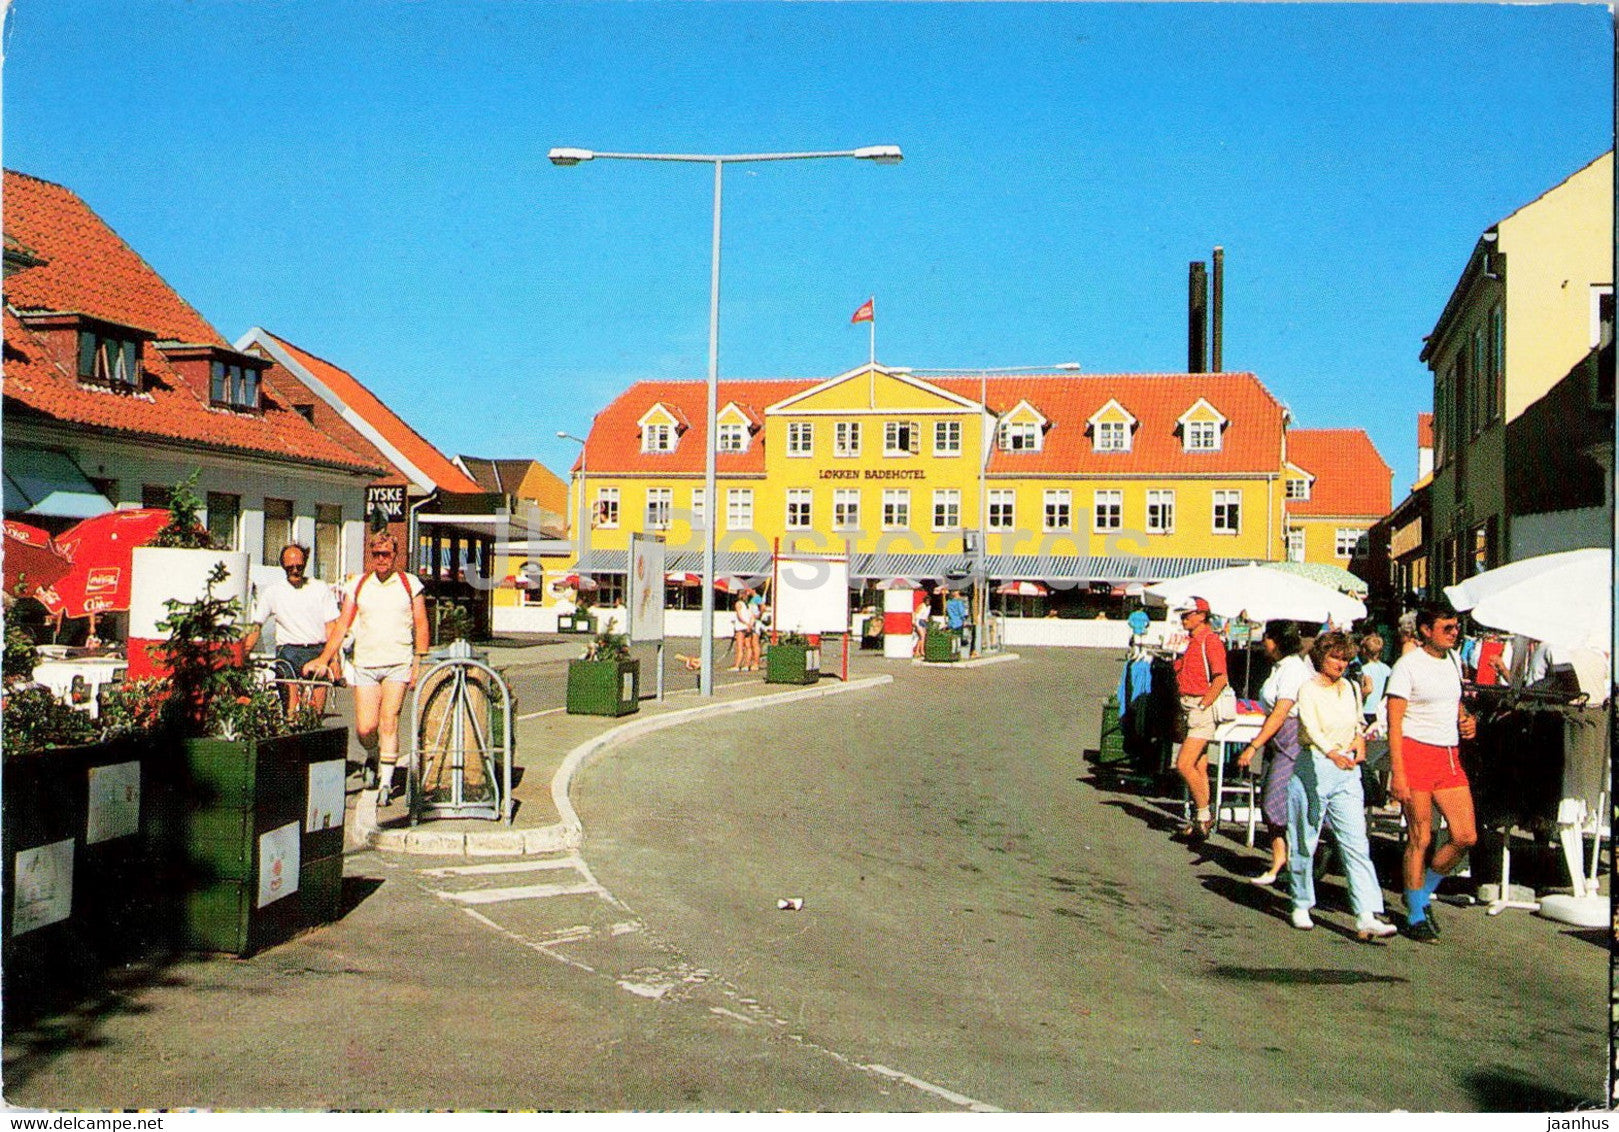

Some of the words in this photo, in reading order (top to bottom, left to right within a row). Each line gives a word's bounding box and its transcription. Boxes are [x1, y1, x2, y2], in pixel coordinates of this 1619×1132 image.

[819, 469, 860, 480] LØKKEN
[864, 469, 926, 480] BADEHOTEL
[368, 487, 404, 502] JYSKE
[366, 501, 403, 515] BNK
